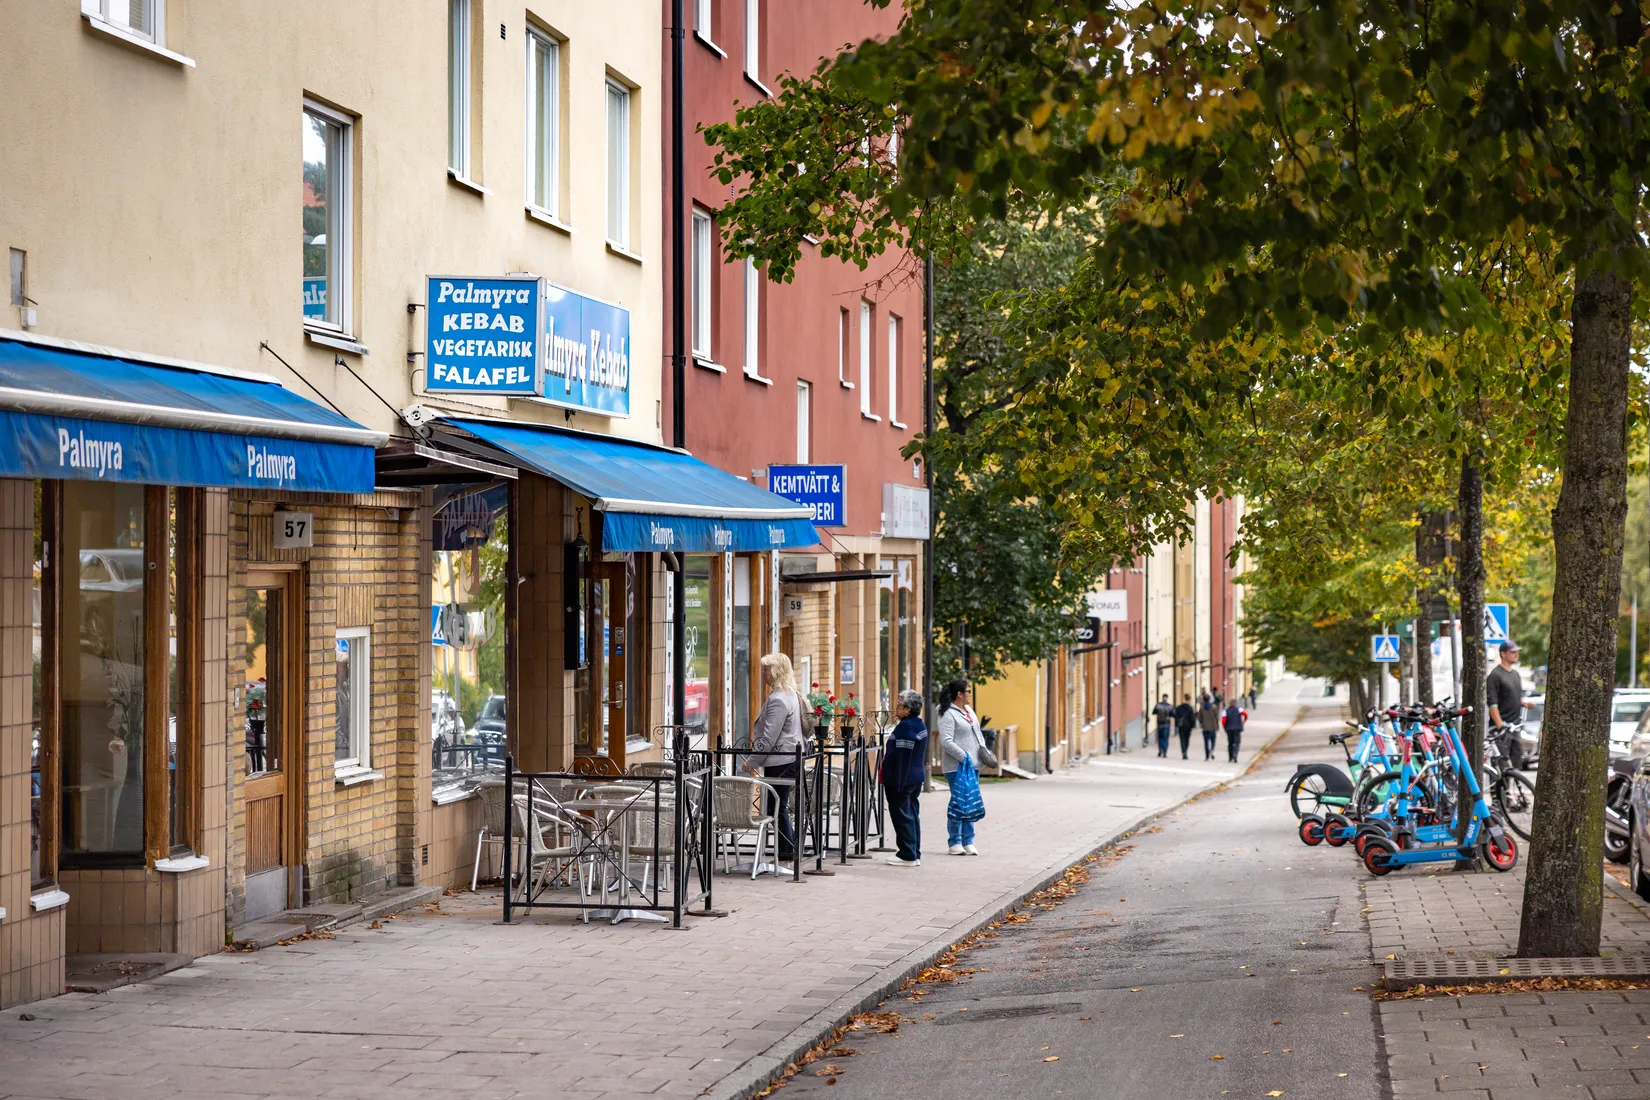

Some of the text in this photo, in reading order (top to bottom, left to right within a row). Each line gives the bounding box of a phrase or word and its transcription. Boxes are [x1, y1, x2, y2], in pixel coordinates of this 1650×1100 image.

[437, 282, 530, 308] Palmyra
[443, 312, 525, 333] KEBAB
[432, 338, 533, 357] VEGETARISK
[590, 329, 628, 391] Kebab
[433, 363, 530, 385] FALAFEL
[59, 427, 123, 477] Palmyra
[247, 445, 296, 487] Palmyra
[773, 470, 840, 494] KEMTVÄTT &
[284, 519, 307, 538] 57
[442, 491, 496, 551] PALMYRA
[650, 521, 674, 550] Palmyra
[790, 600, 802, 611] 59
[442, 602, 497, 651] KEBAB
